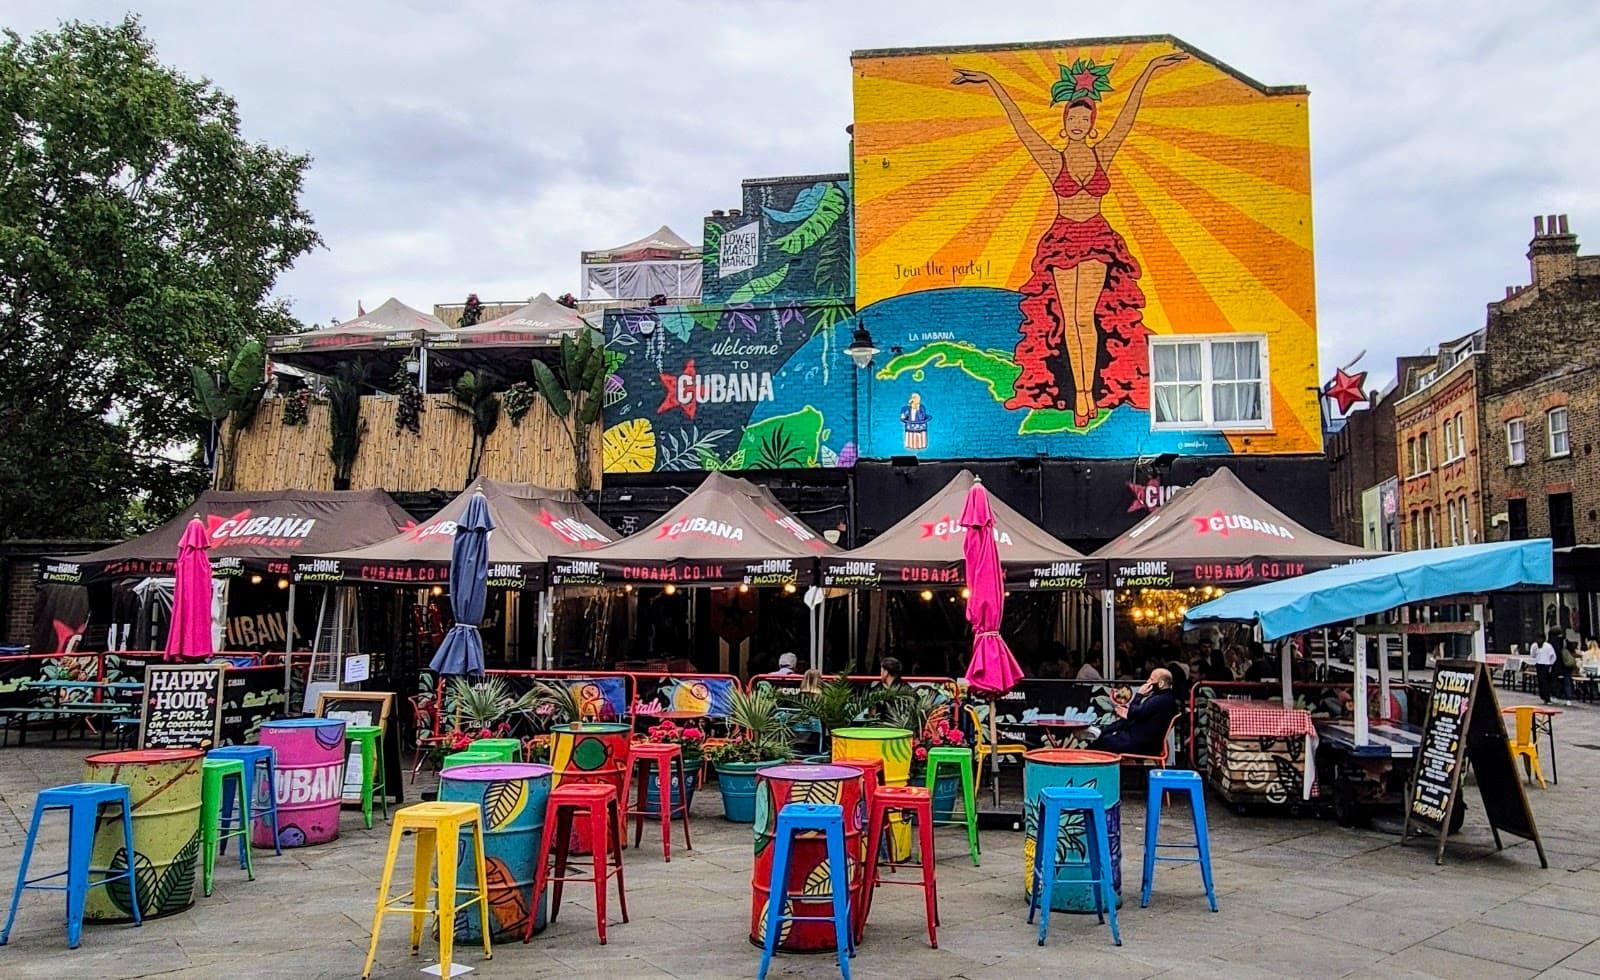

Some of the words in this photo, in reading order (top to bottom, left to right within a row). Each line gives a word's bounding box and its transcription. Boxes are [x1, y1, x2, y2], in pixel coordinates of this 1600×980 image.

[724, 232, 756, 245] LOWER
[723, 243, 756, 256] MARSH
[722, 254, 756, 268] MARKET
[893, 264, 921, 280] Join
[926, 261, 944, 277] the
[909, 333, 919, 341] LA
[922, 332, 955, 341] HABANA
[710, 336, 779, 356] Welcome
[732, 361, 749, 370] TO
[677, 371, 775, 404] CUBANA
[212, 517, 316, 539] CUBANA
[668, 517, 743, 541] CUBANA
[1209, 514, 1295, 540] CUBANA
[298, 563, 313, 572] THE
[313, 560, 340, 574] HOME
[494, 564, 521, 578] HOME
[556, 565, 572, 574] THE
[572, 561, 600, 575] HOME
[623, 565, 723, 581] CUBANA.CO.UK
[746, 565, 763, 574] THE
[763, 559, 793, 573] HOME
[829, 566, 846, 574] THE
[846, 562, 876, 576] HOME
[1033, 567, 1051, 577] THE
[1051, 562, 1082, 577] HOME
[1120, 566, 1137, 576] THE
[1137, 561, 1167, 576] HOME
[1194, 562, 1304, 580] CUBANA.CO.UK
[553, 575, 560, 584] OF
[744, 575, 752, 585] OF
[753, 569, 798, 585] MOJITOS!
[825, 576, 834, 585] OF
[836, 572, 882, 588] MOJITOS!
[1029, 578, 1039, 588] OF
[1040, 572, 1088, 589] MOJITOS!
[1116, 577, 1125, 587] OF
[1127, 570, 1174, 588] MOJITOS!
[150, 671, 218, 691] HAPPY
[1435, 670, 1475, 694] STREET
[155, 692, 208, 710] HOUR
[1438, 692, 1461, 715] BAR
[152, 710, 209, 721] 2-FOR-1
[148, 721, 165, 729] ON
[166, 720, 214, 729] COCKTAILS
